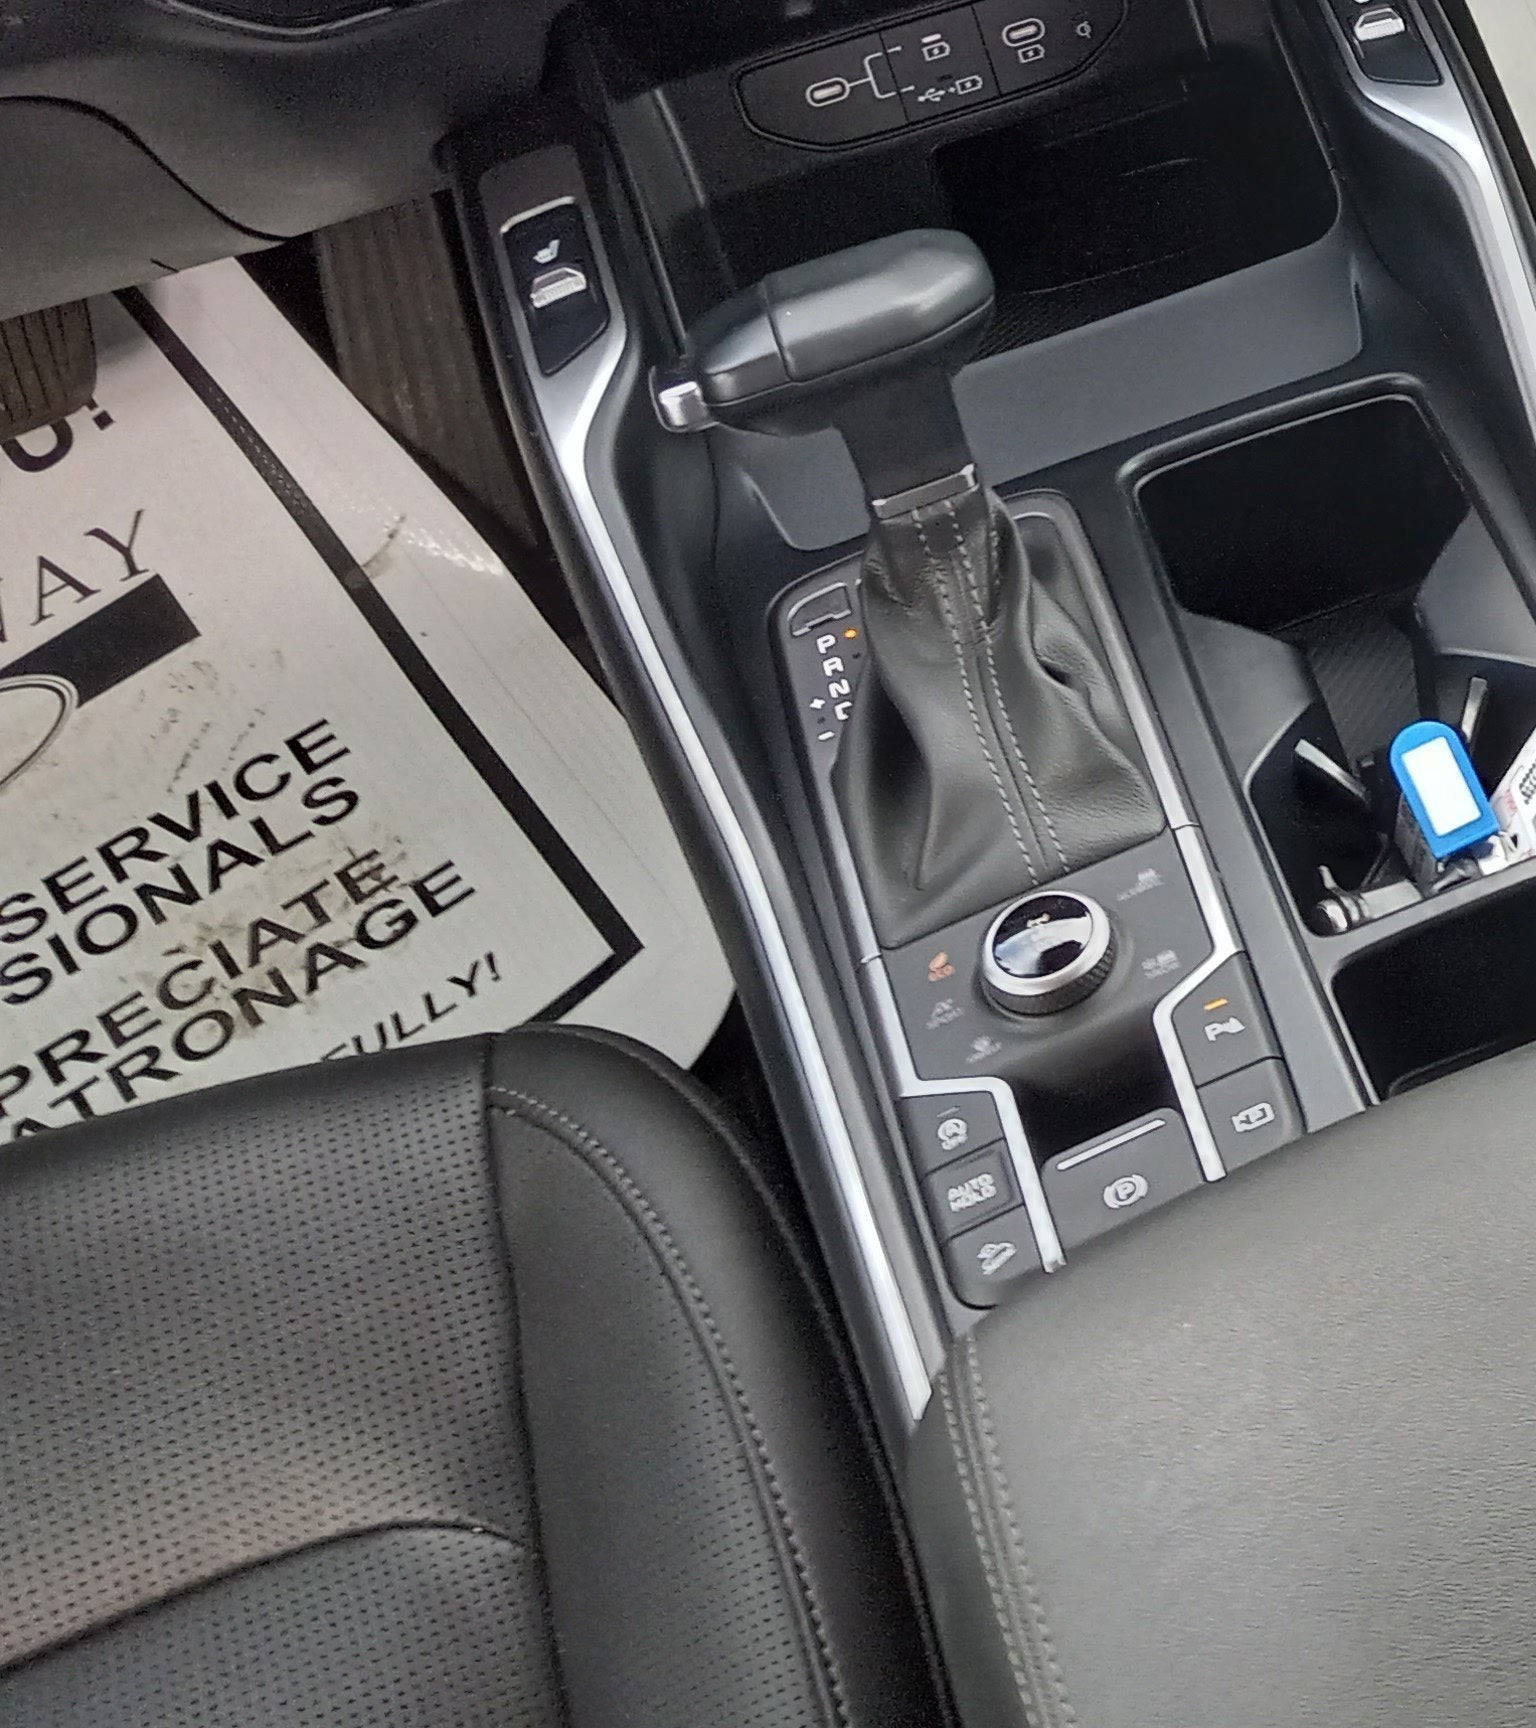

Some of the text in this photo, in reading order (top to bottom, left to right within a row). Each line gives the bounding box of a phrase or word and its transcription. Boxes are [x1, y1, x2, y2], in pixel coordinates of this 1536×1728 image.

[816, 634, 836, 654] P
[829, 678, 851, 698] N
[0, 719, 351, 944] SERVICE
[947, 1173, 995, 1202] AUTO
